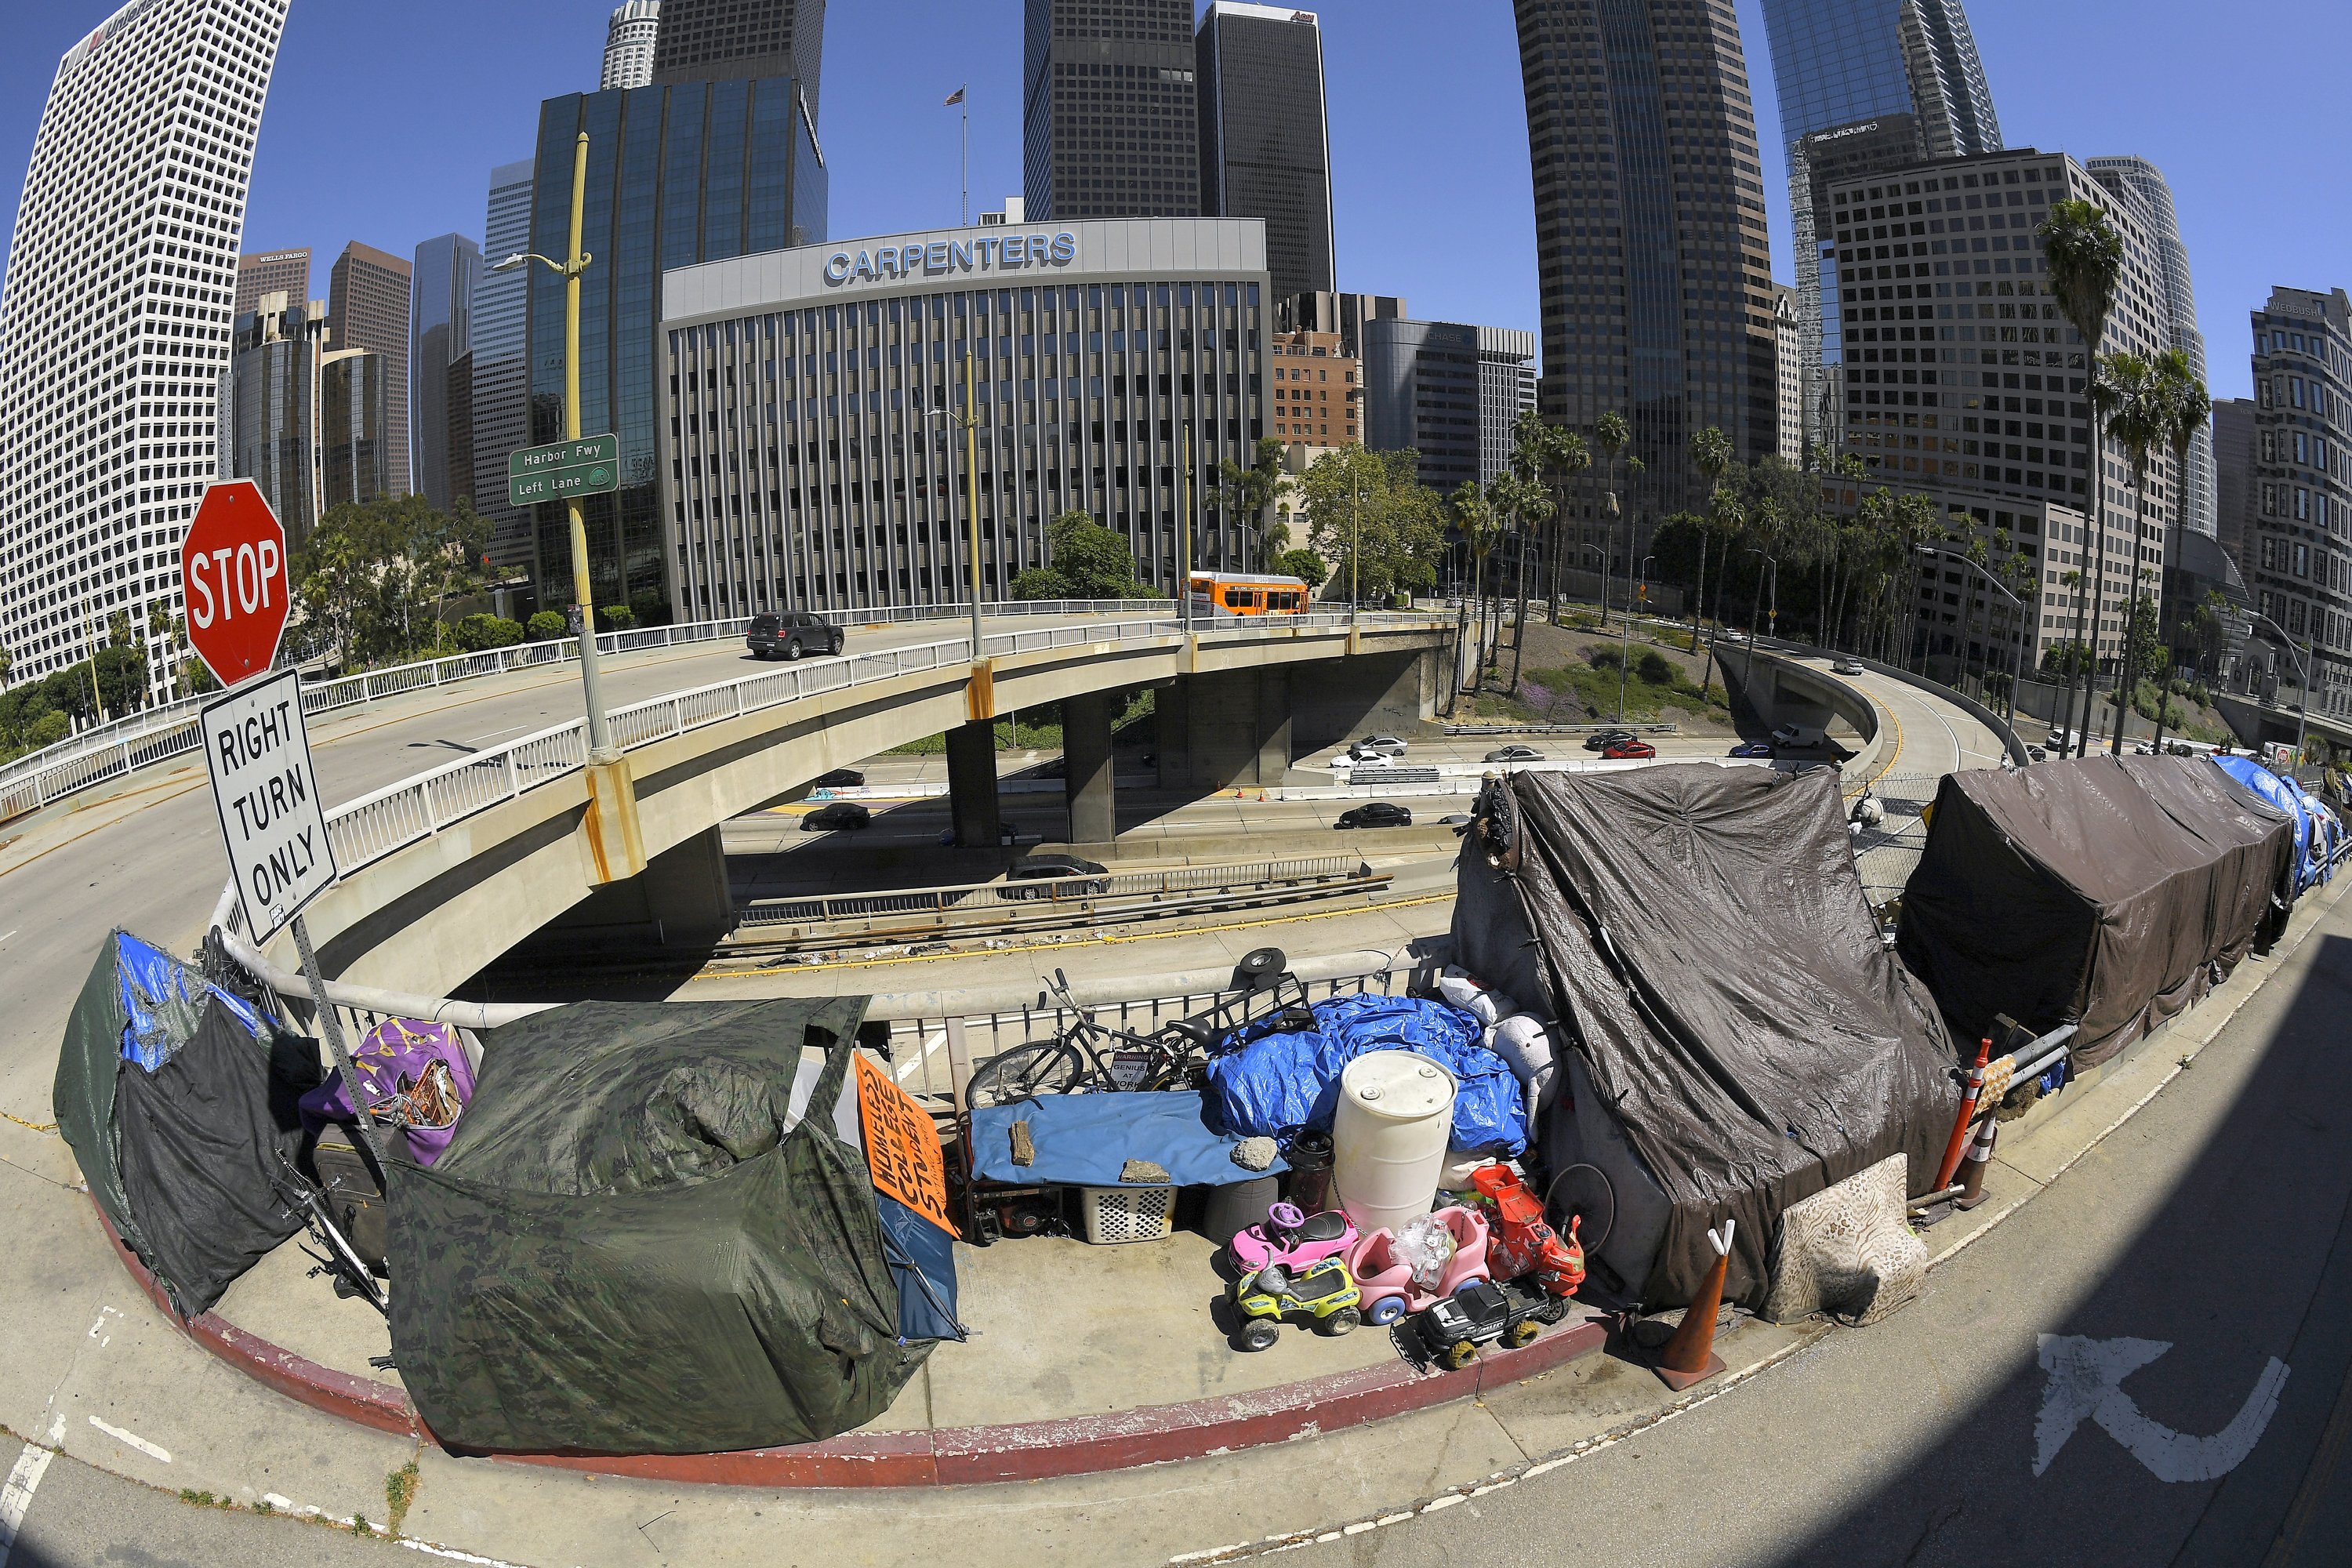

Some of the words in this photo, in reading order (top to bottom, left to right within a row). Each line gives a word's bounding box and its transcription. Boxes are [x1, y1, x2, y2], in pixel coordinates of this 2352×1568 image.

[260, 254, 284, 263] WELLS
[826, 232, 1076, 280] CARPENTERS
[1428, 332, 1461, 343] CHASE
[2270, 301, 2318, 317] WEDBUSH
[519, 481, 543, 495] Left
[551, 477, 581, 490] Lane
[524, 450, 566, 466] Harbor
[575, 445, 601, 458] Fwy
[191, 539, 279, 630] STOP
[218, 700, 290, 776] RIGHT
[233, 763, 306, 841] TURN
[252, 825, 314, 906] ONLY
[860, 1063, 897, 1189] HOMELESS
[878, 1078, 919, 1206] COLLEGE
[897, 1090, 942, 1219] STUDENT
